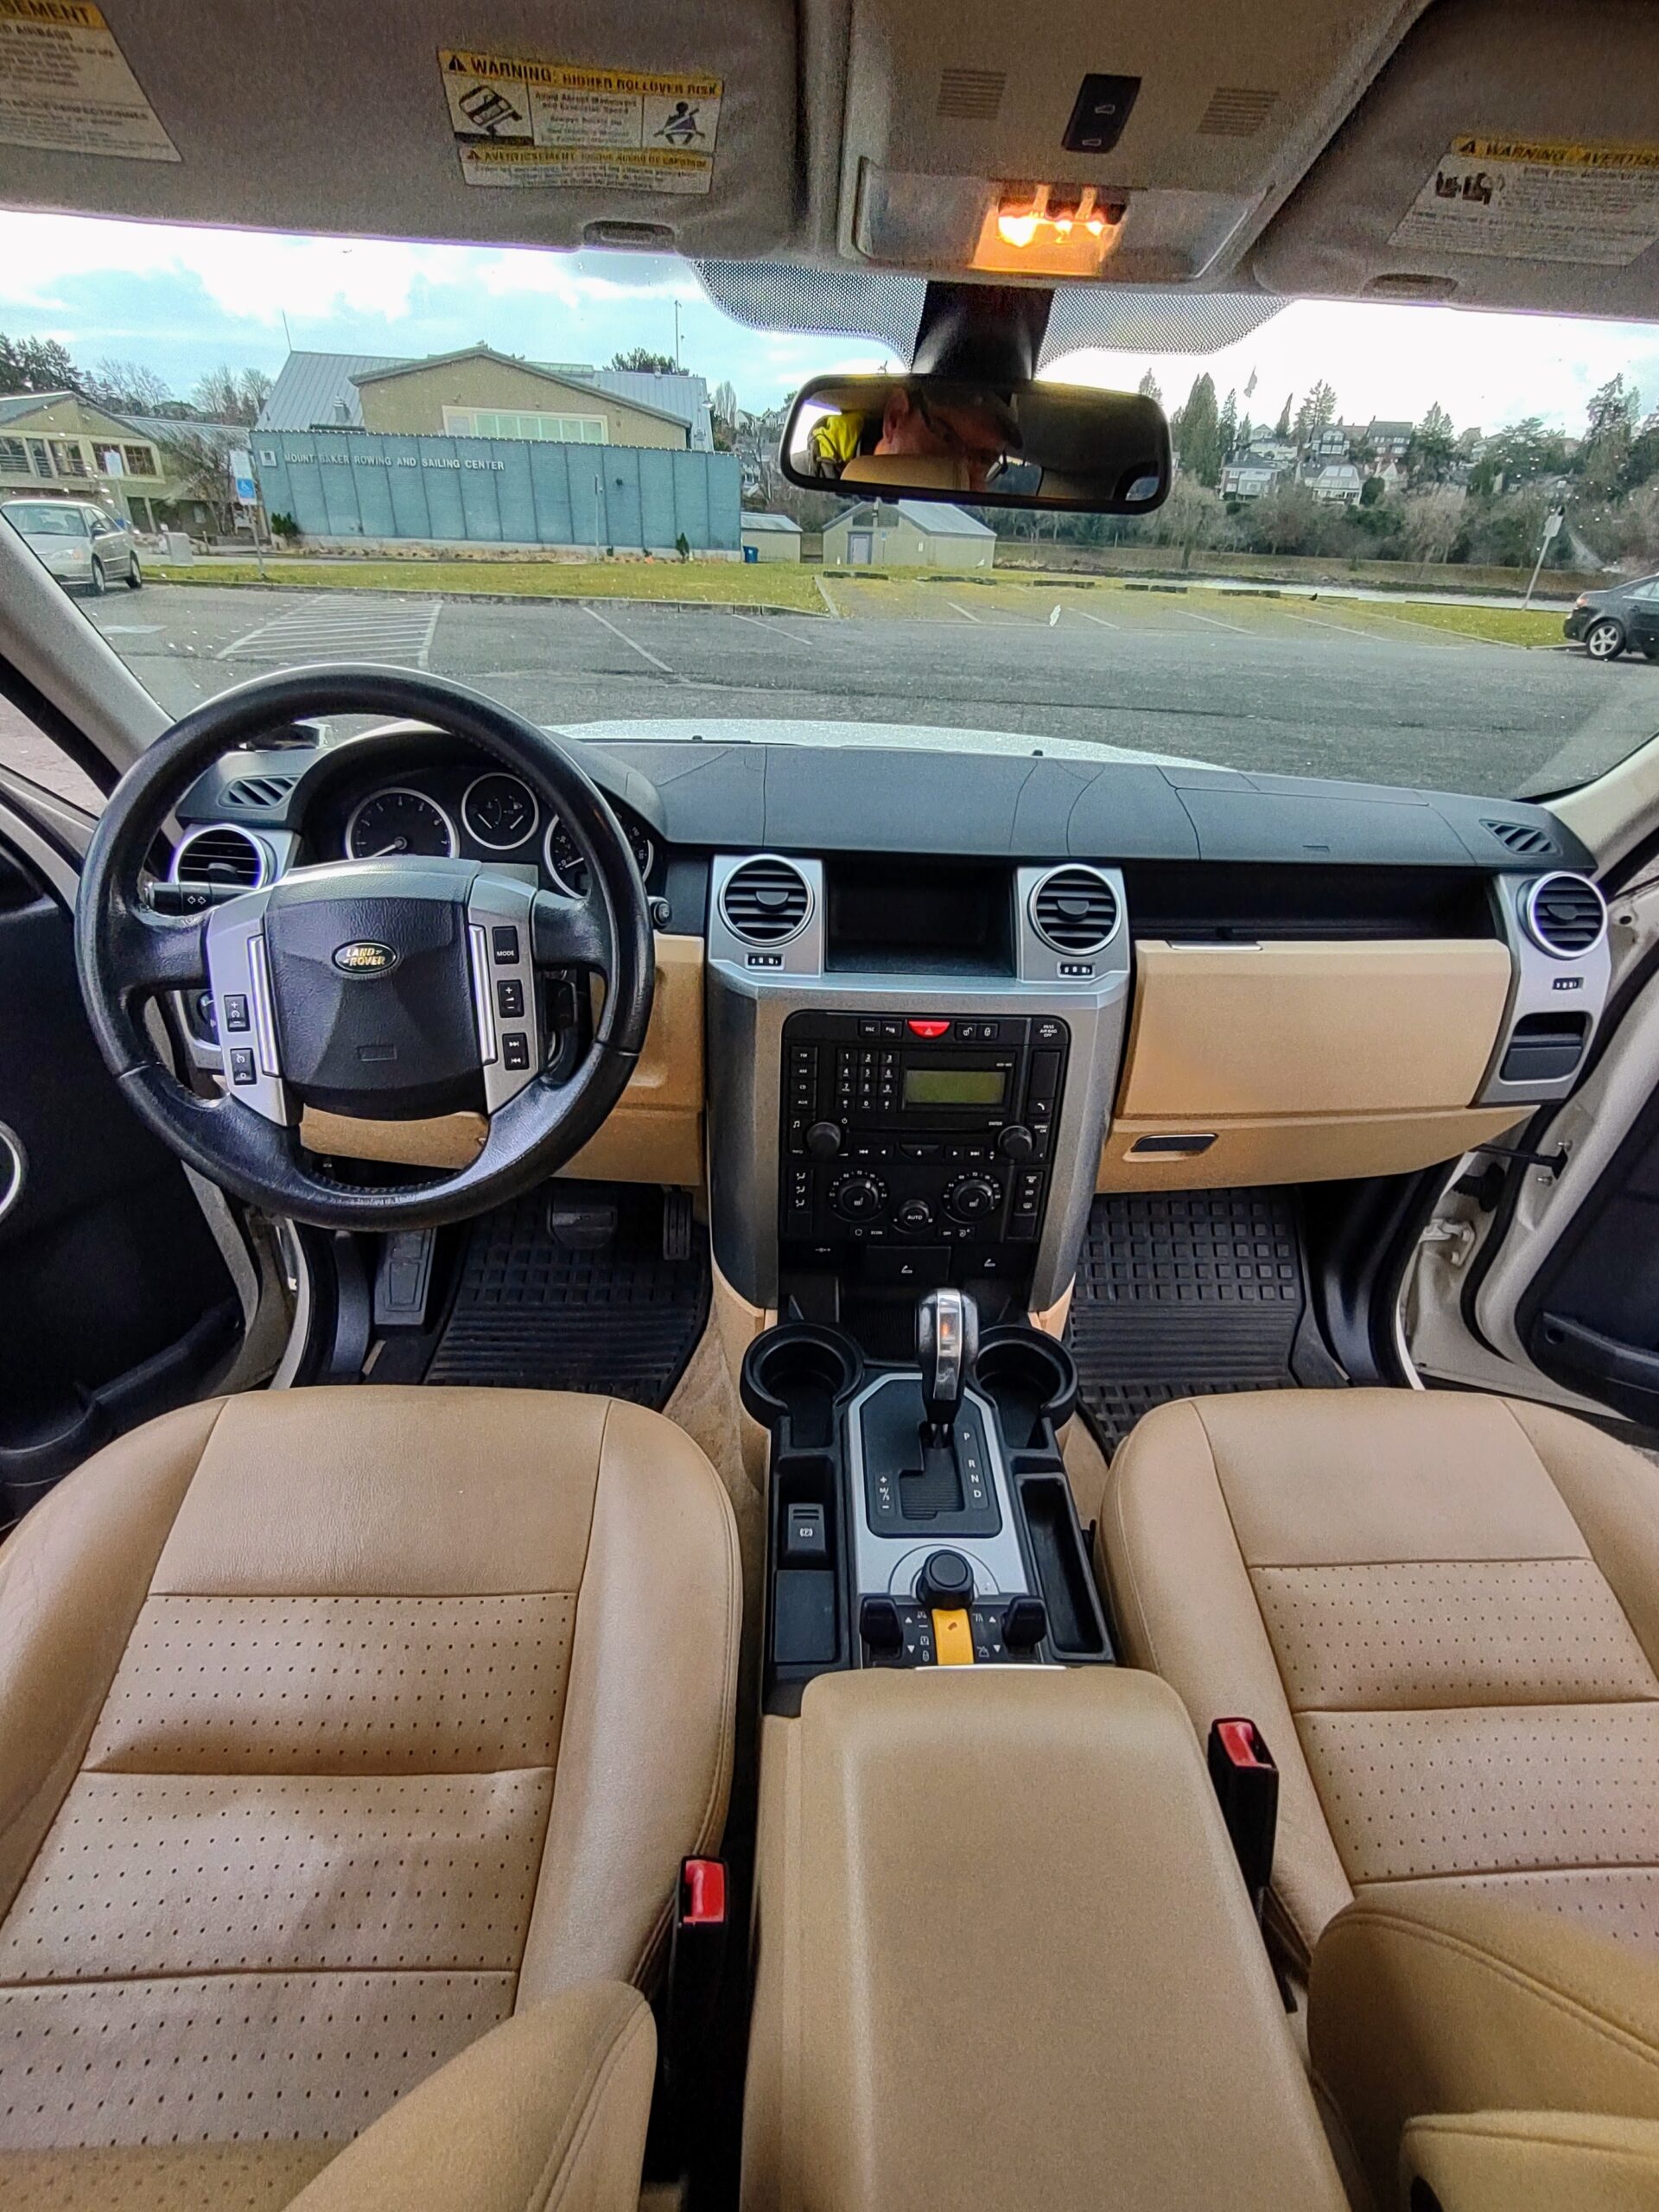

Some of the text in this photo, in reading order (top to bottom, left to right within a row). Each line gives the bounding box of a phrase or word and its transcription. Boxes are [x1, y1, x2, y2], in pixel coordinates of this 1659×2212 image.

[284, 453, 505, 471] MOUNT BAKER ROWING AND SAILING CENTER
[346, 948, 375, 957] LAND
[349, 956, 385, 967] ROVER
[963, 1432, 970, 1441] P
[968, 1459, 976, 1469] R
[970, 1474, 979, 1483] N
[973, 1489, 982, 1498] D
